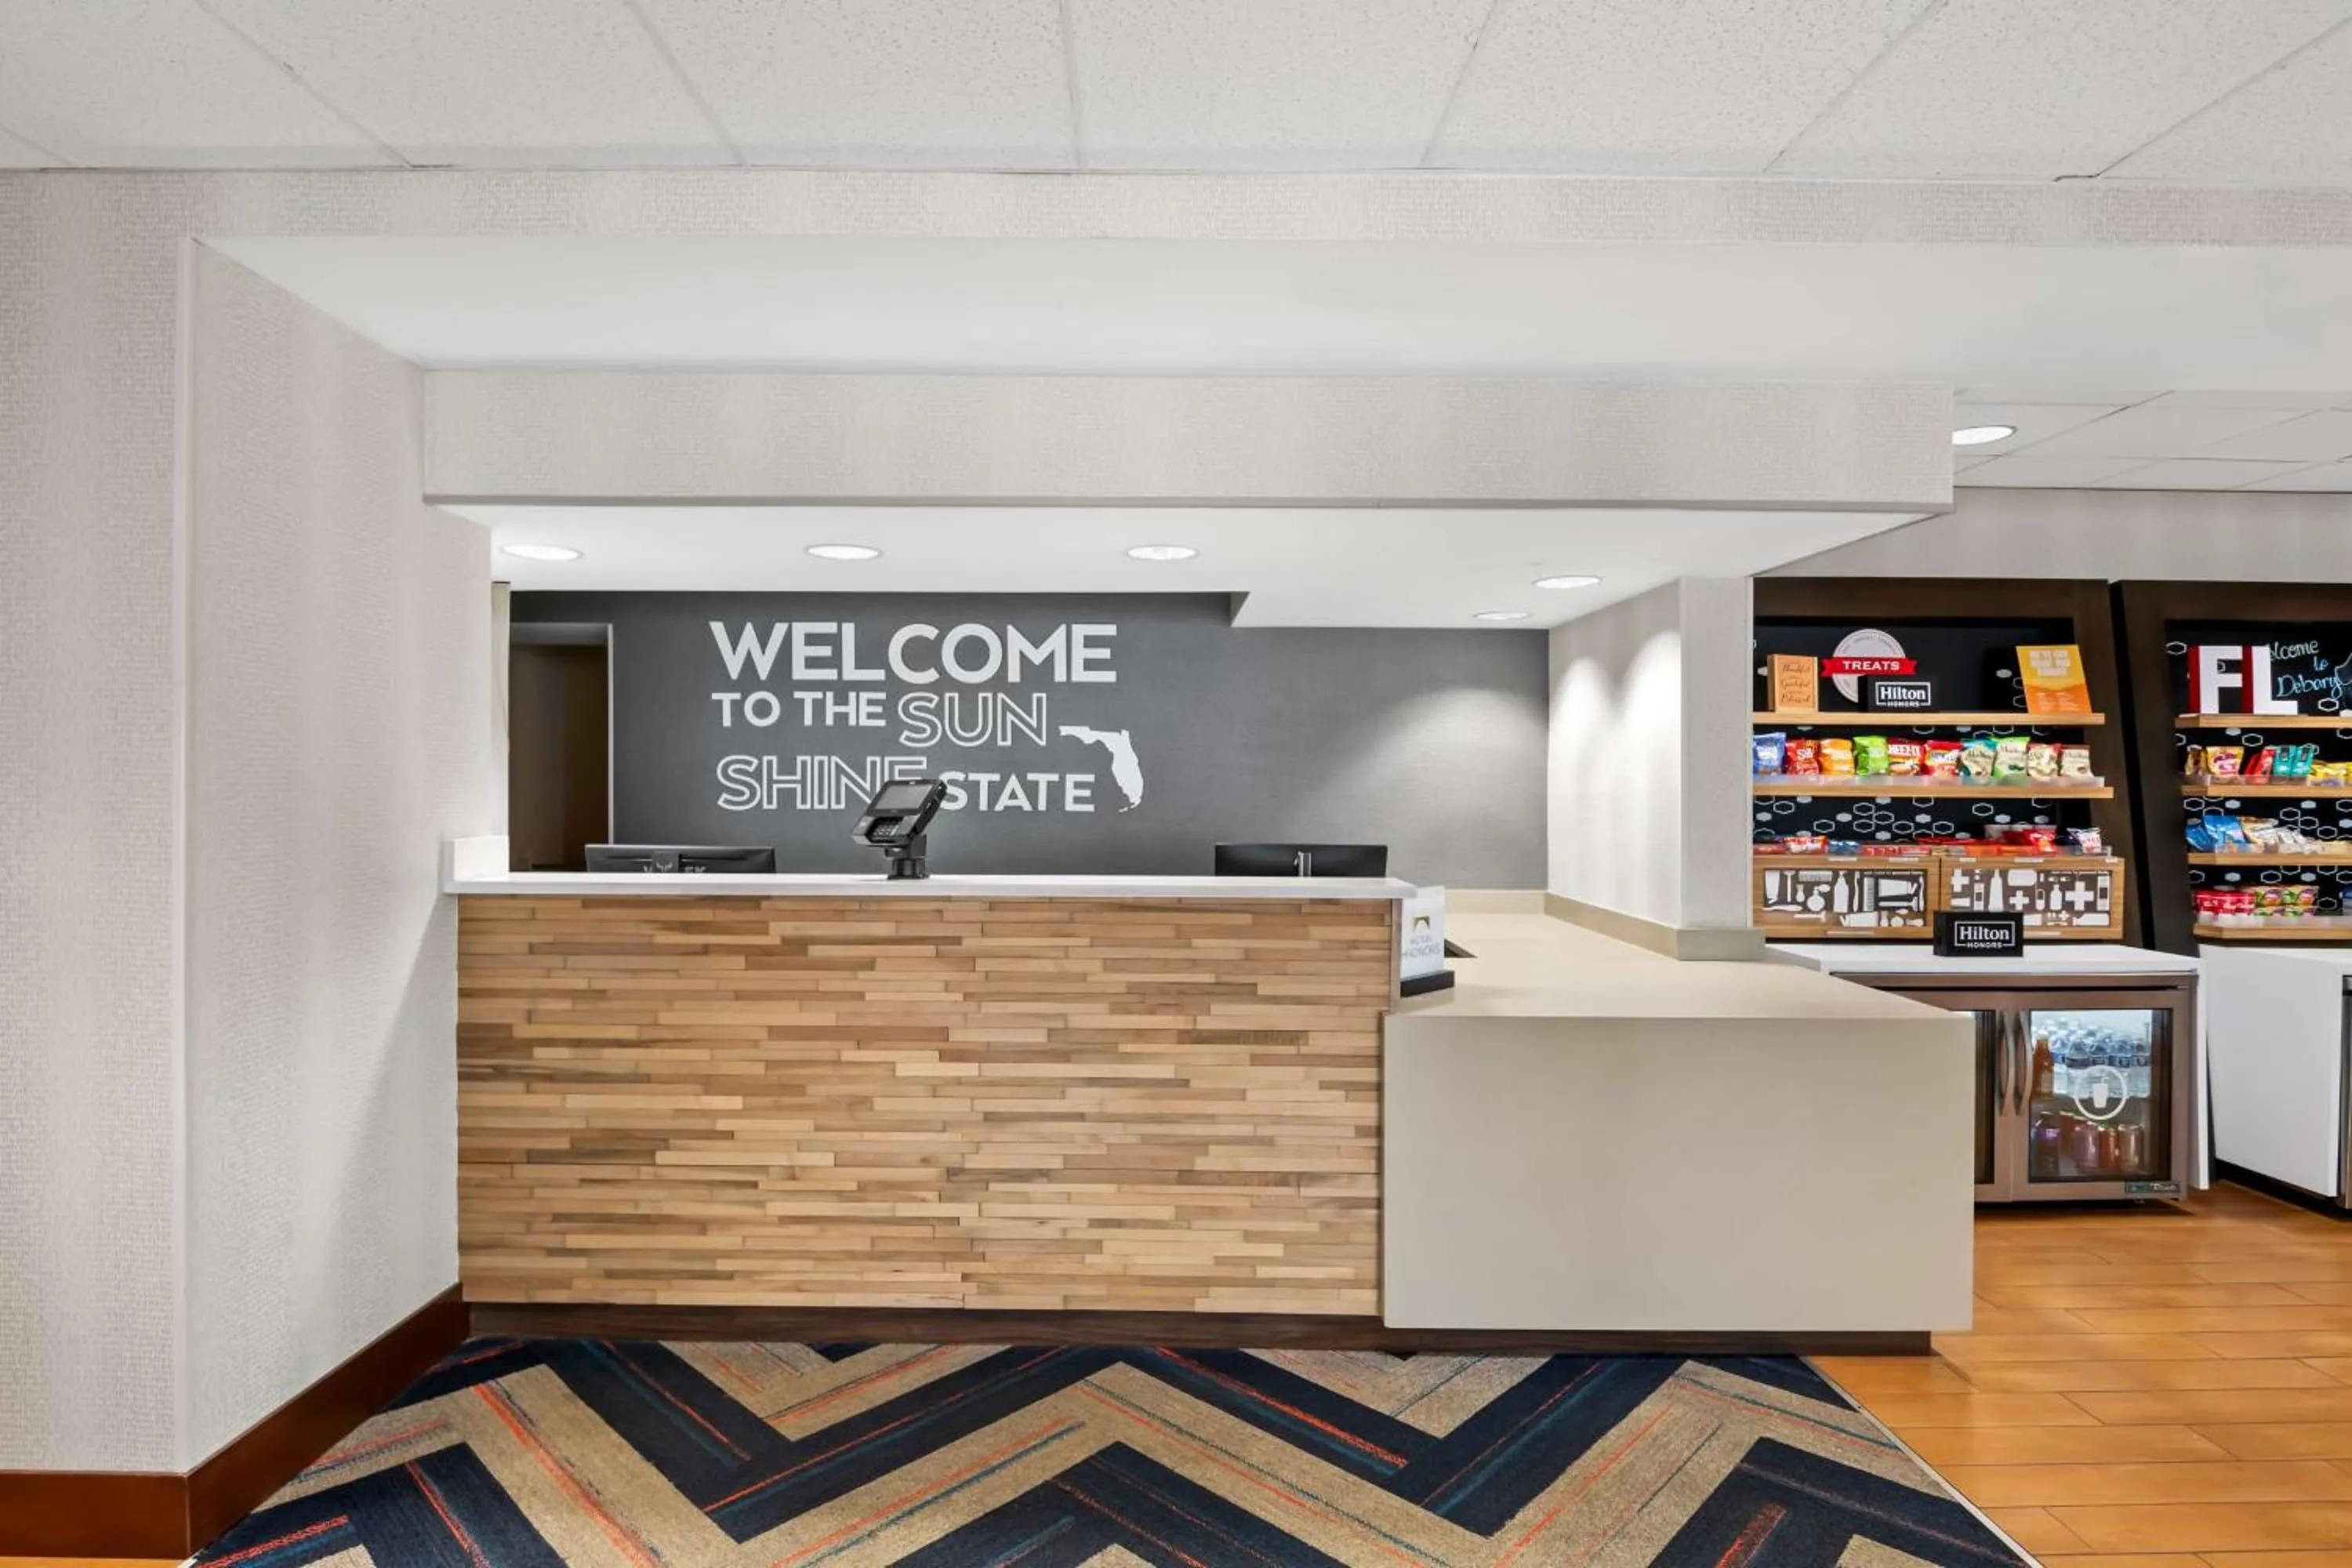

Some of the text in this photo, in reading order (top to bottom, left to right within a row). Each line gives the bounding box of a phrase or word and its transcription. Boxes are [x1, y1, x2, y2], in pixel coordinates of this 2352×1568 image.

[710, 621, 1117, 684] WELCOME
[1842, 660, 1900, 670] TREATS
[2270, 640, 2319, 661] lcome
[1880, 686, 1926, 700] Hilton
[2198, 644, 2299, 715] FL
[711, 691, 1047, 748] TO THE SUN
[938, 771, 1095, 812] STATE
[1959, 926, 2009, 940] Hilton
